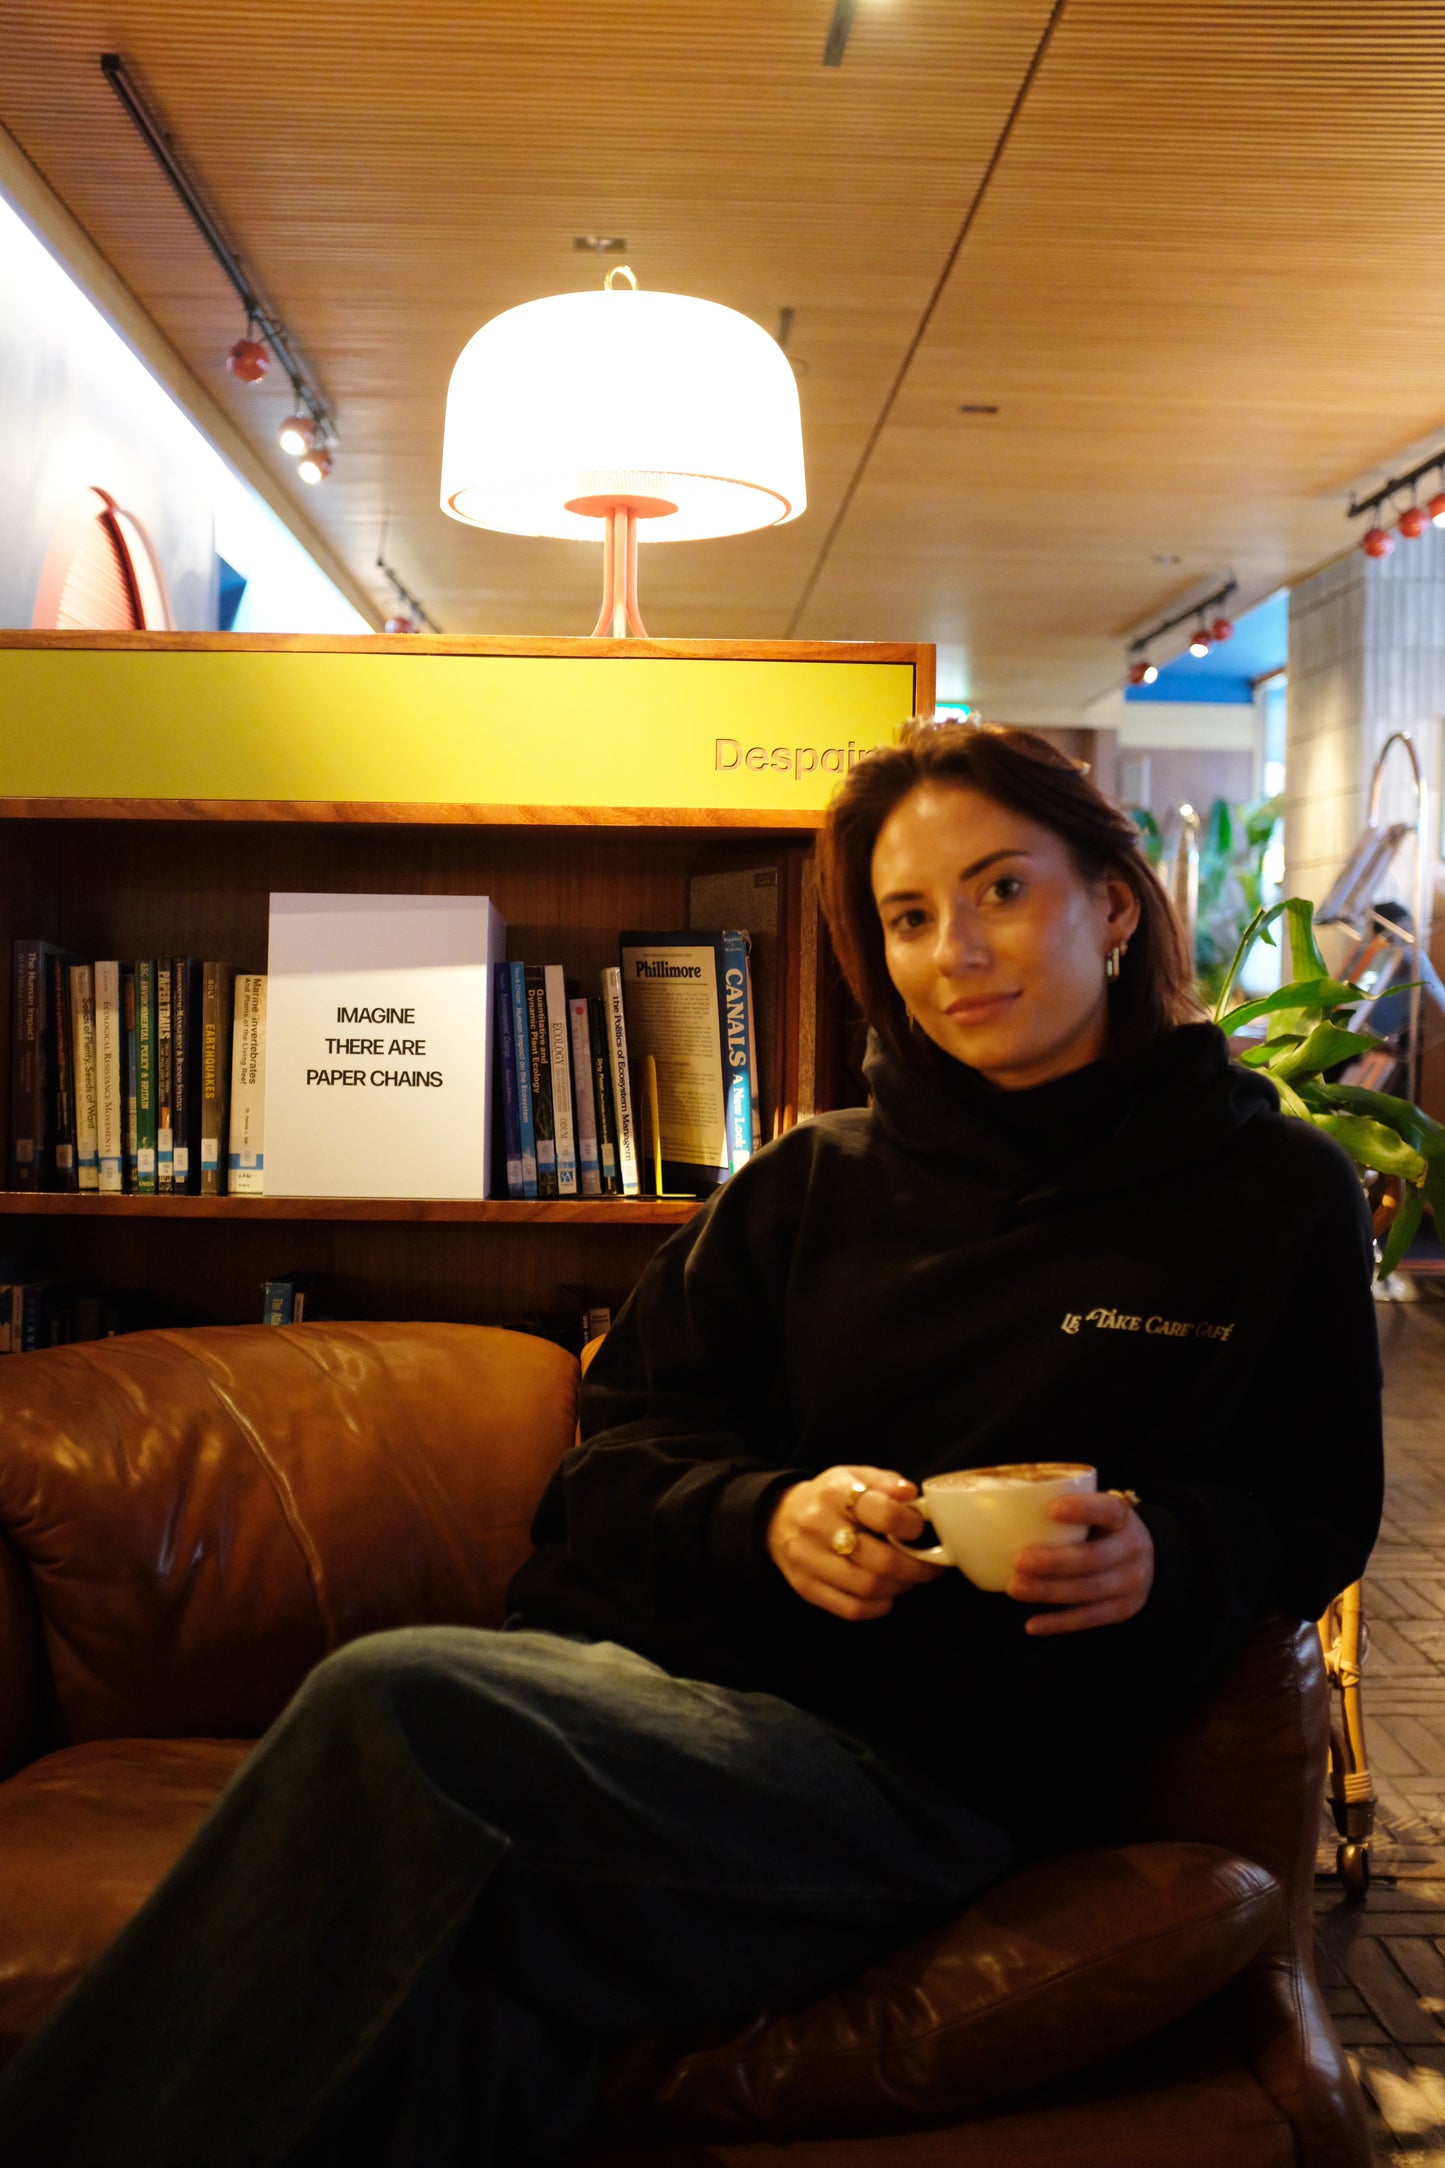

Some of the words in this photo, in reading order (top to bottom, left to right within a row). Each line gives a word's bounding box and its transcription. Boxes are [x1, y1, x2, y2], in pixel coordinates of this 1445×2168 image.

[27, 951, 37, 969] The
[635, 960, 702, 979] Phillimore
[26, 971, 36, 1005] Human
[158, 971, 171, 1003] PAPER
[207, 979, 215, 999] BOLT
[252, 978, 262, 1013] Marine
[82, 998, 92, 1025] Seeds
[140, 980, 149, 1042] ENVIRONMENTAL
[243, 994, 251, 1017] Plants
[337, 1007, 415, 1024] IMAGINE
[527, 989, 537, 1030] Dynamic
[536, 988, 547, 1045] Quantitative
[725, 968, 747, 1067] CANALS
[25, 1007, 35, 1042] Impact
[83, 1026, 92, 1035] of
[103, 1001, 112, 1051] ECOLOGICAL
[158, 1003, 171, 1040] TRAILS
[243, 1019, 249, 1027] of
[515, 1007, 524, 1034] Human
[614, 1014, 623, 1048] Politics
[83, 1037, 93, 1065] Plenty,
[240, 1043, 248, 1066] Living
[249, 1017, 260, 1085] invertebrates
[325, 1038, 385, 1055] THERE
[388, 1039, 426, 1056] ARE
[516, 1035, 525, 1060] Impact
[530, 1031, 539, 1055] Plant
[540, 1046, 548, 1064] and
[617, 1049, 625, 1059] of
[140, 1044, 149, 1071] POLICY
[204, 1023, 216, 1100] EARTHQUAKES
[519, 1061, 526, 1071] on
[85, 1066, 96, 1092] Seeds
[104, 1053, 112, 1099] RESISTANCE
[306, 1069, 366, 1086] PAPER
[370, 1070, 443, 1088] CHAINS
[519, 1072, 527, 1083] the
[532, 1056, 541, 1093] Ecology
[552, 1022, 565, 1066] ECOLOGY
[559, 1118, 568, 1139] ODUM
[618, 1061, 629, 1112] Ecosystem
[733, 1073, 744, 1085] A
[86, 1094, 96, 1103] of
[140, 1079, 149, 1110] BRITAIN
[519, 1084, 529, 1124] Ecosystem
[733, 1087, 745, 1116] New
[87, 1105, 95, 1129] Want
[104, 1102, 112, 1153] MOVEMENTS
[621, 1114, 632, 1161] Managem
[734, 1117, 747, 1149] Look
